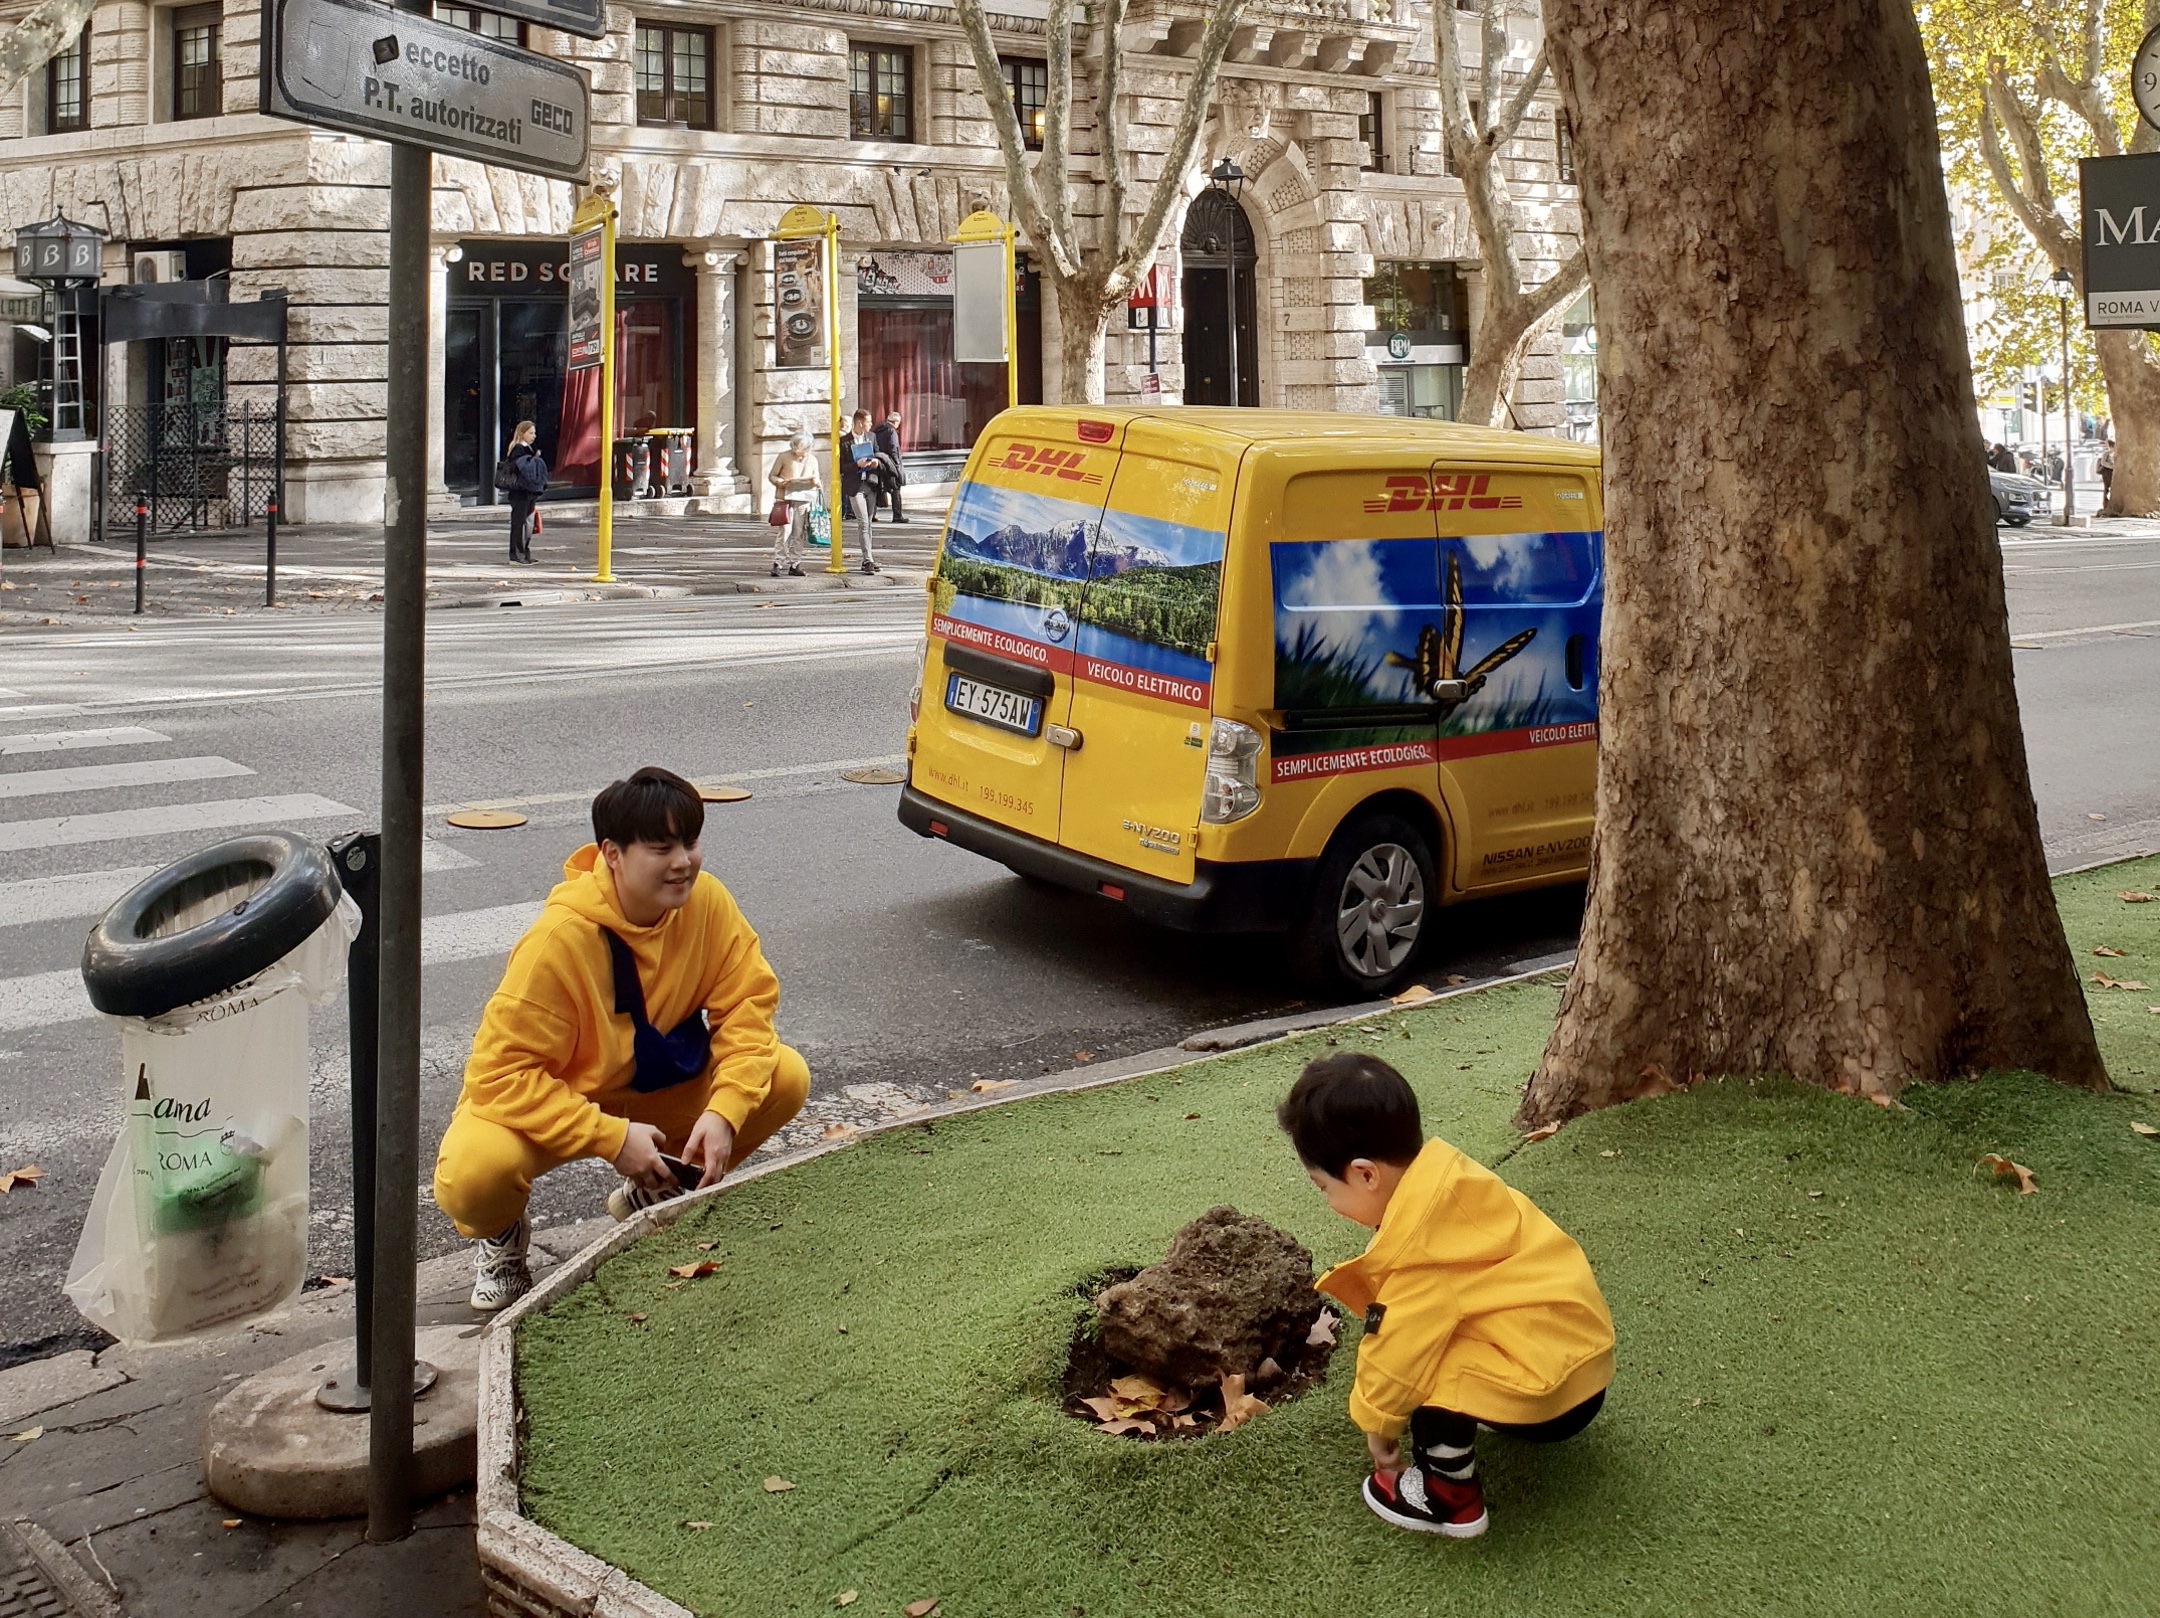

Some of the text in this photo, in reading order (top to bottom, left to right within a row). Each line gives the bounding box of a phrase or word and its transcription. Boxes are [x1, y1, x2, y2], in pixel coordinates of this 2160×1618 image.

[405, 41, 491, 86] eccetto
[2144, 71, 2158, 93] 9
[364, 76, 523, 145] P.T. autorizzati
[468, 261, 659, 283] RED SQRE
[1283, 313, 1292, 327] 7
[2097, 301, 2145, 316] ROMA
[1001, 442, 1088, 482] DHL
[1385, 475, 1501, 513] DHL
[933, 617, 1049, 664] SEMPLICEMENTE ECOLOGICO.
[1086, 660, 1202, 702] VEICOLO ELETTRICO
[1529, 726, 1567, 743] VEICOLO
[1276, 750, 1369, 777] SEMPLICEMENTE
[928, 766, 1034, 815] www.dhl.it 199.199.345
[1483, 845, 1535, 866] NISSAN
[157, 1150, 213, 1172] ROMA
